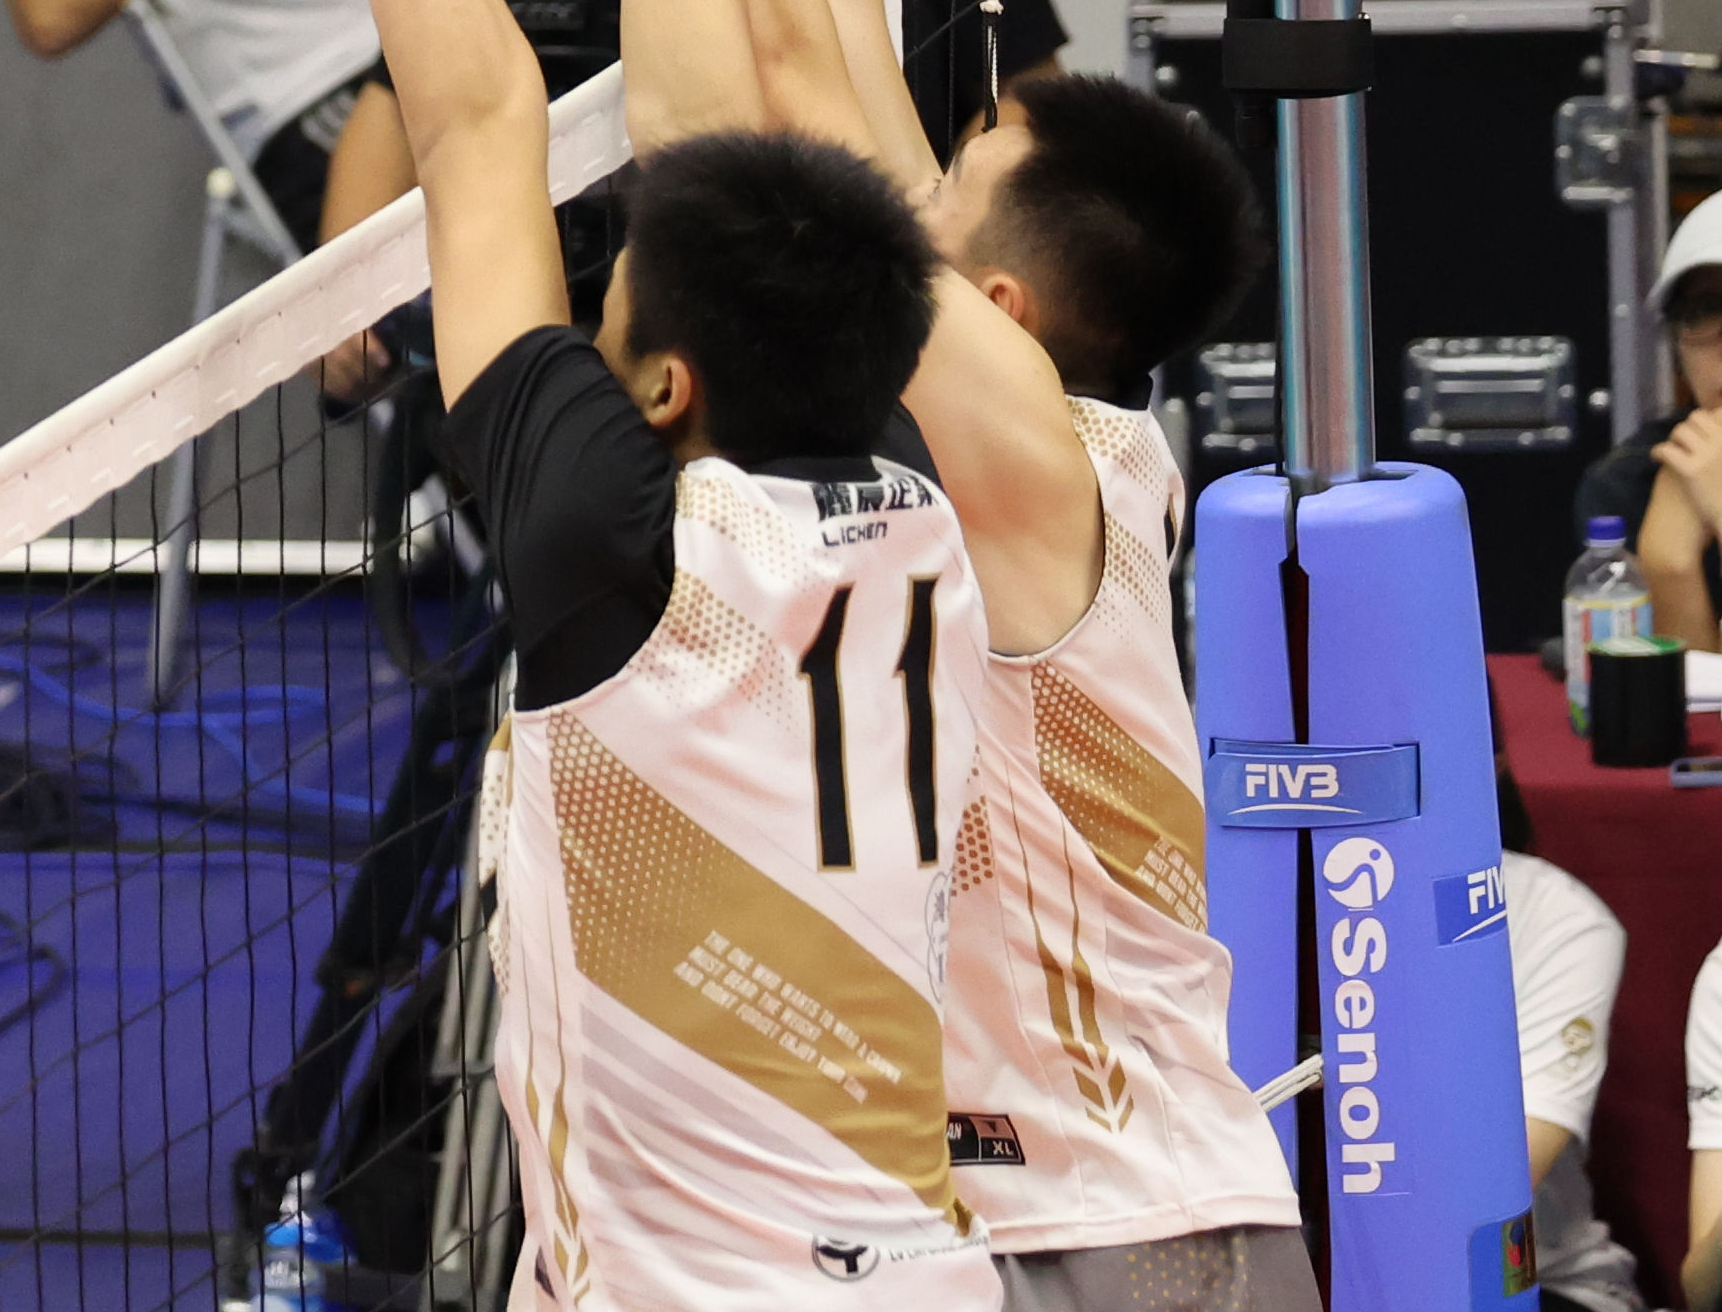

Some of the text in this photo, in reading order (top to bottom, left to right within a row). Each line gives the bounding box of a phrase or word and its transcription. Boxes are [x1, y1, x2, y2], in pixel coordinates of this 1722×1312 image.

[797, 573, 942, 873] 11
[1244, 763, 1341, 799] FIVB
[1467, 865, 1507, 915] FIV
[1331, 917, 1396, 1196] Senoh
[947, 1122, 962, 1140] AN
[992, 1141, 1014, 1156] XL
